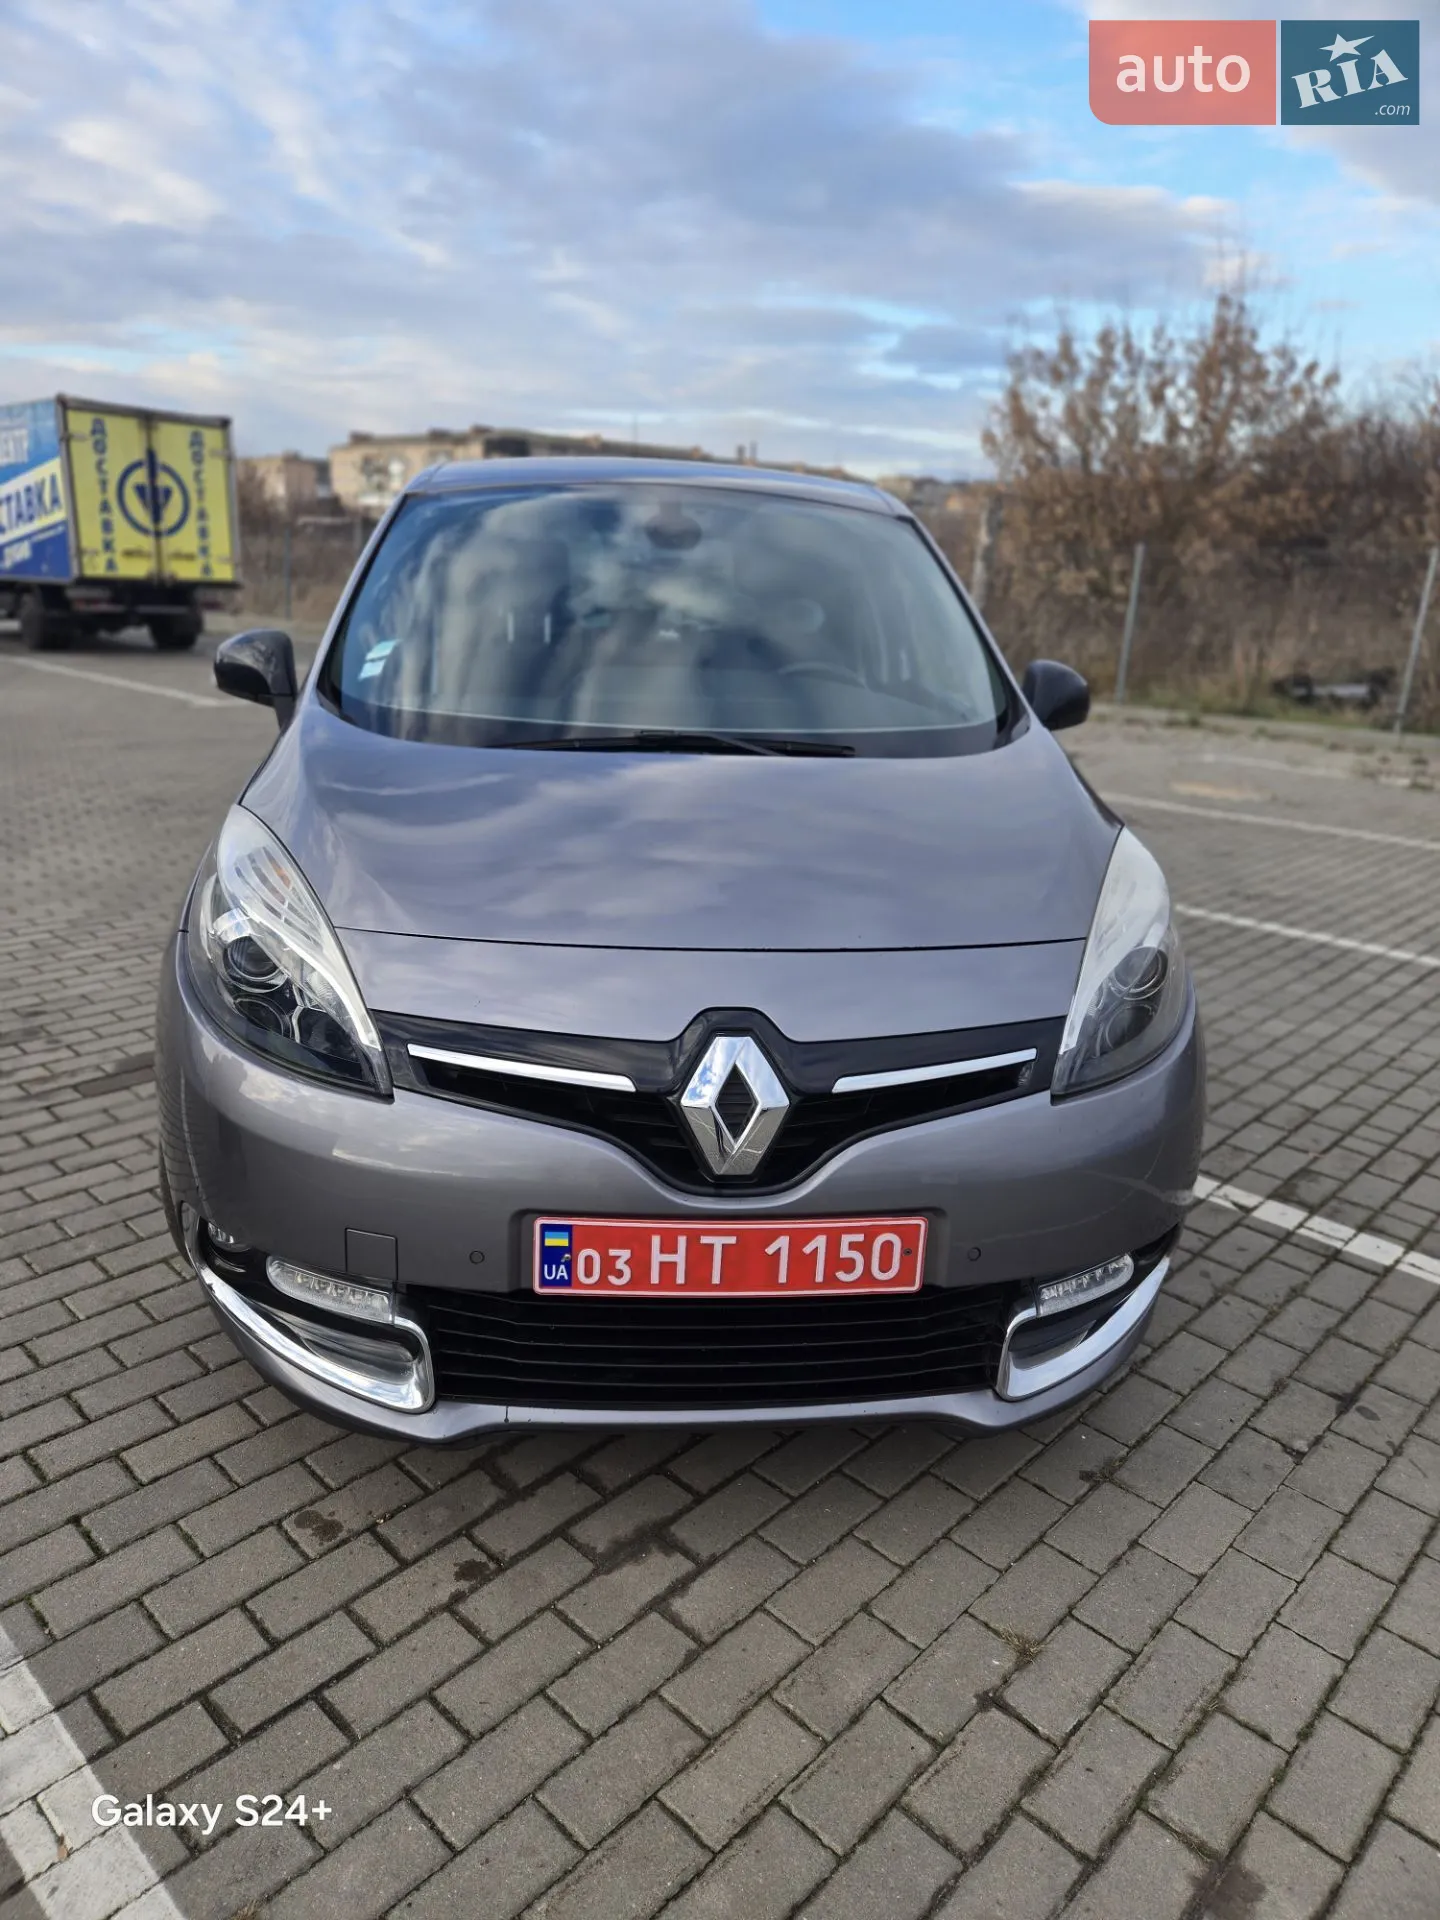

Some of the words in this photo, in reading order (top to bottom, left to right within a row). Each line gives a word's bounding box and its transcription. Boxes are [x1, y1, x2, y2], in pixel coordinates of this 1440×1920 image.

[544, 1264, 569, 1281] UA
[576, 1248, 632, 1286] 03
[650, 1234, 738, 1285] HT
[764, 1232, 902, 1284] 1150
